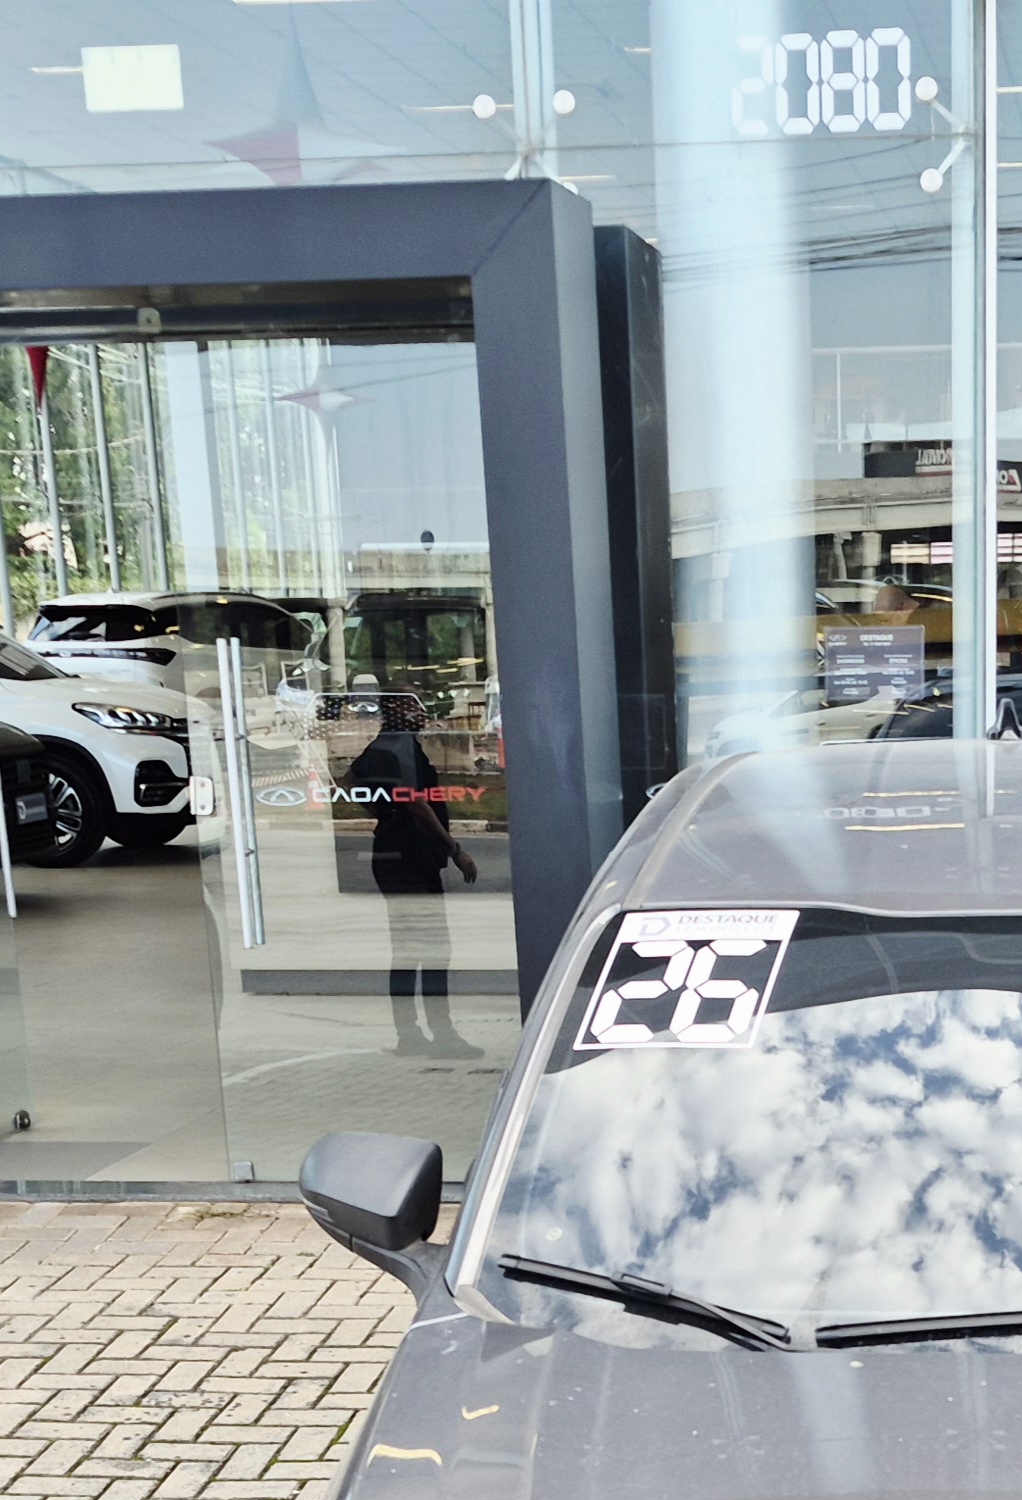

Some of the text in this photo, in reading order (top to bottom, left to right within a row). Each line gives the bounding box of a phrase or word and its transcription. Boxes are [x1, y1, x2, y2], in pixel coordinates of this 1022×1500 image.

[731, 26, 911, 136] 2080
[678, 914, 778, 924] DESTAQUE
[590, 939, 767, 1044] 26
